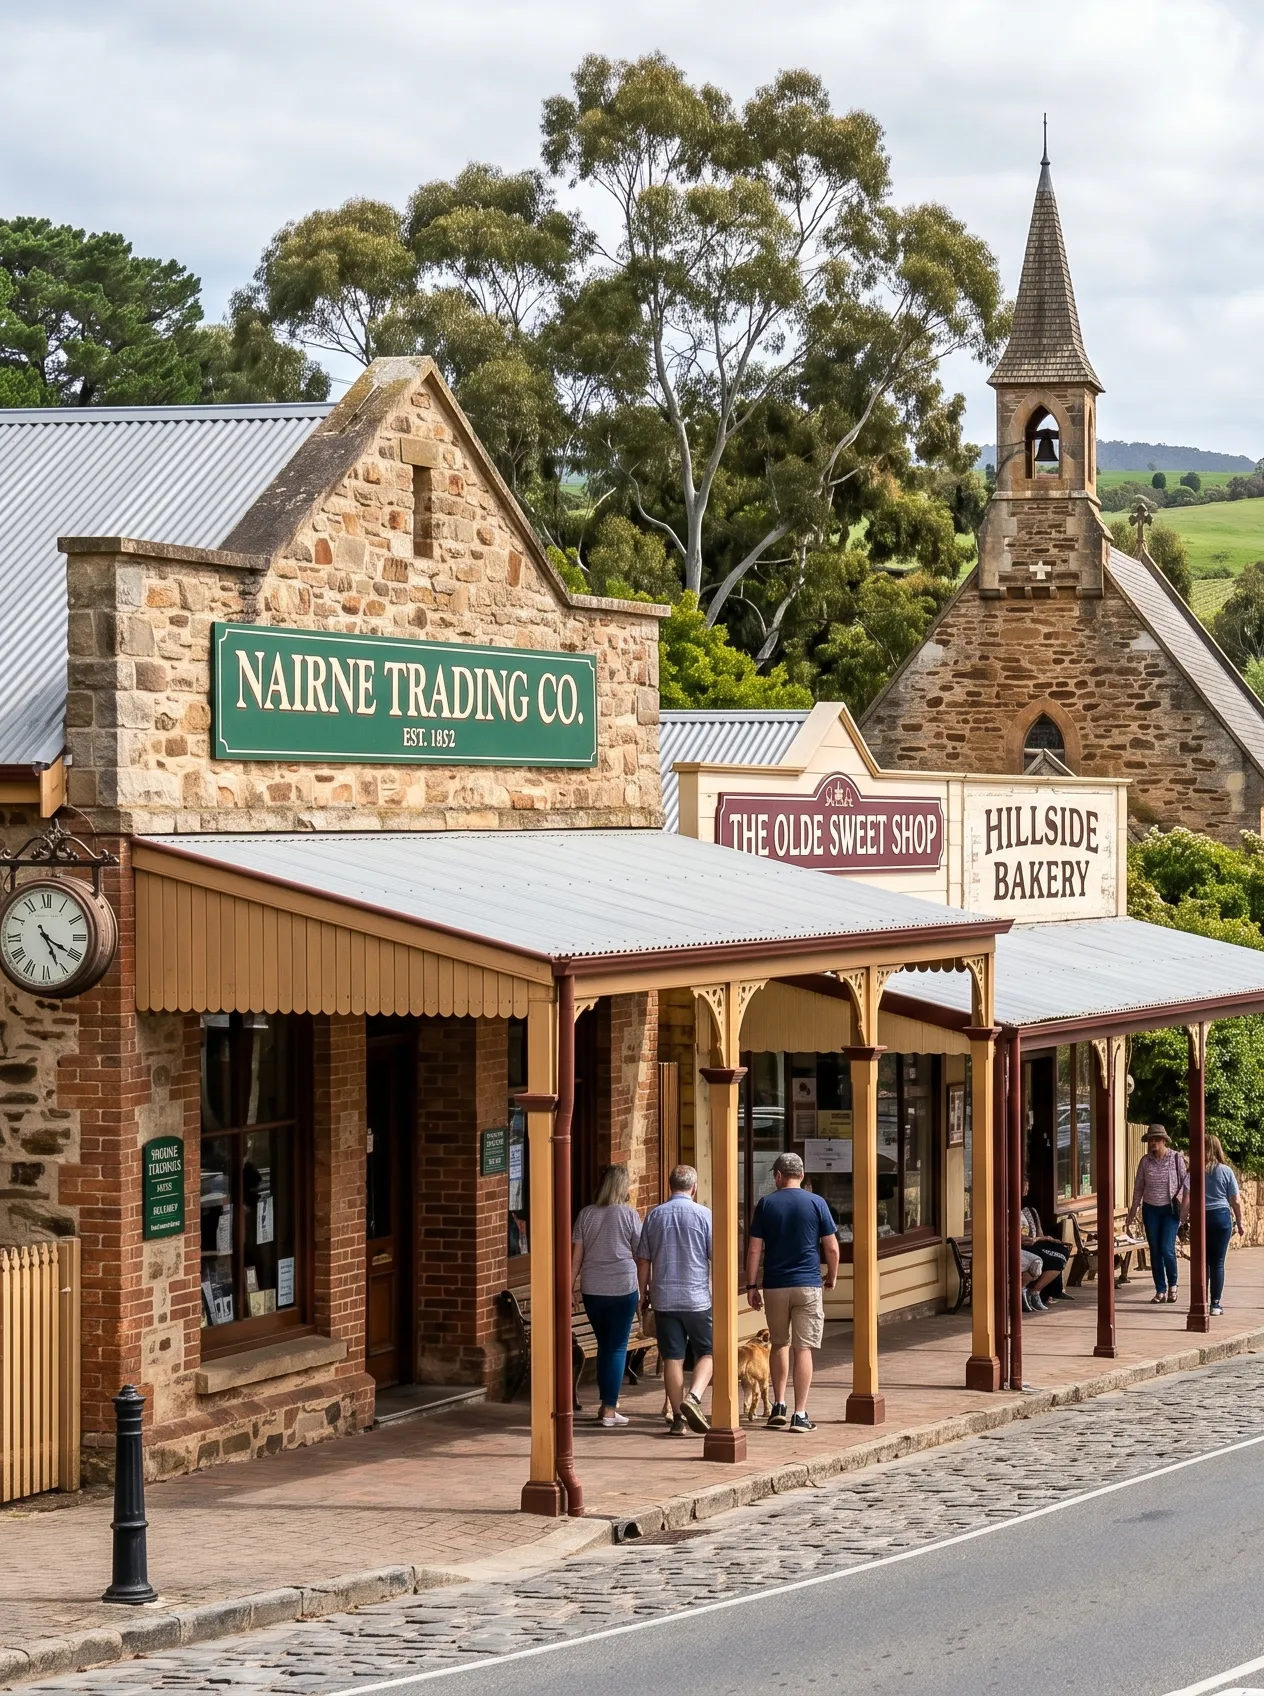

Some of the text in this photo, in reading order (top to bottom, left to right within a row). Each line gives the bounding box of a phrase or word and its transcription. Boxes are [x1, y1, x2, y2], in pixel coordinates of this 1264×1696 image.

[235, 650, 584, 725] NAIRNE TRADING CO.
[403, 727, 456, 747] EST. 1852
[729, 813, 937, 857] THE OLDE SWEET SHOP
[985, 805, 1099, 855] HILLSIDE
[993, 860, 1090, 901] BAKERY
